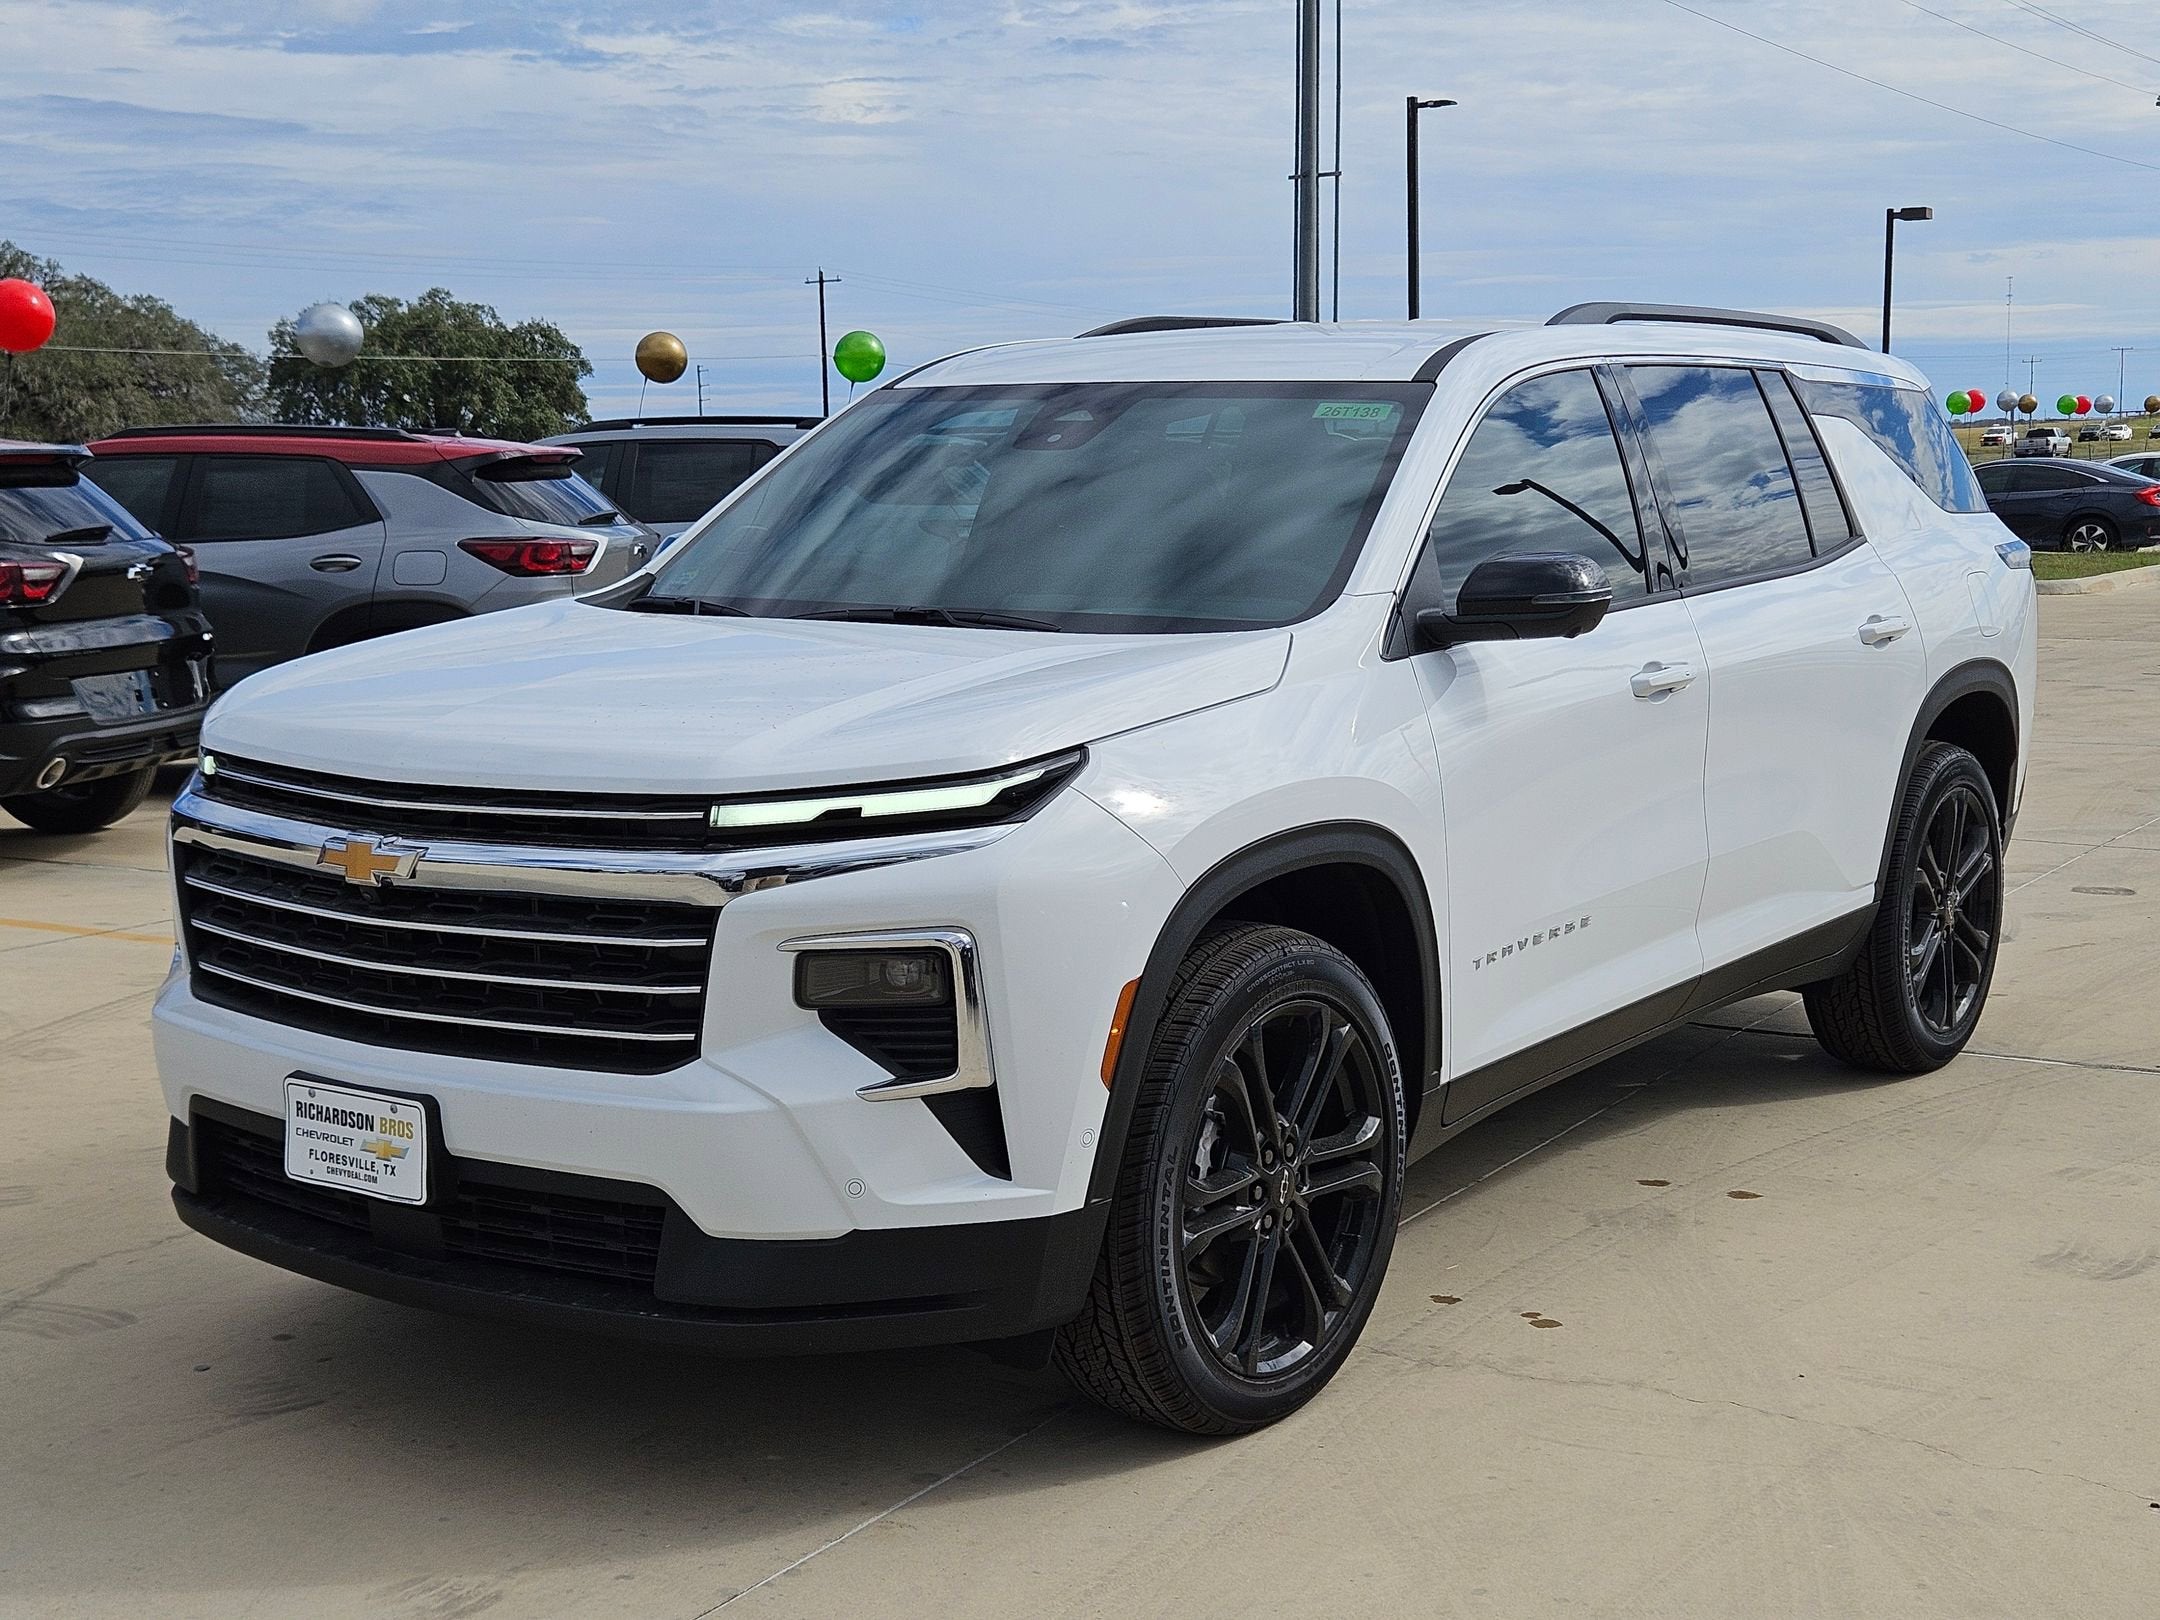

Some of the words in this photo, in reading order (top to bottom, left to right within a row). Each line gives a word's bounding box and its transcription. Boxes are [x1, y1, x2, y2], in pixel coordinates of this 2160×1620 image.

[1321, 406, 1381, 418] 26T138
[1472, 915, 1592, 971] TRAVERSE
[295, 1100, 375, 1132] RICHARDSON
[379, 1116, 414, 1140] BROS
[295, 1127, 355, 1147] CHEVROLET
[308, 1148, 379, 1175] FLORESVILLE,
[383, 1163, 397, 1177] TX
[326, 1165, 378, 1184] CHEVYDEAL.COM
[1159, 1146, 1188, 1350] CONTINENTAL
